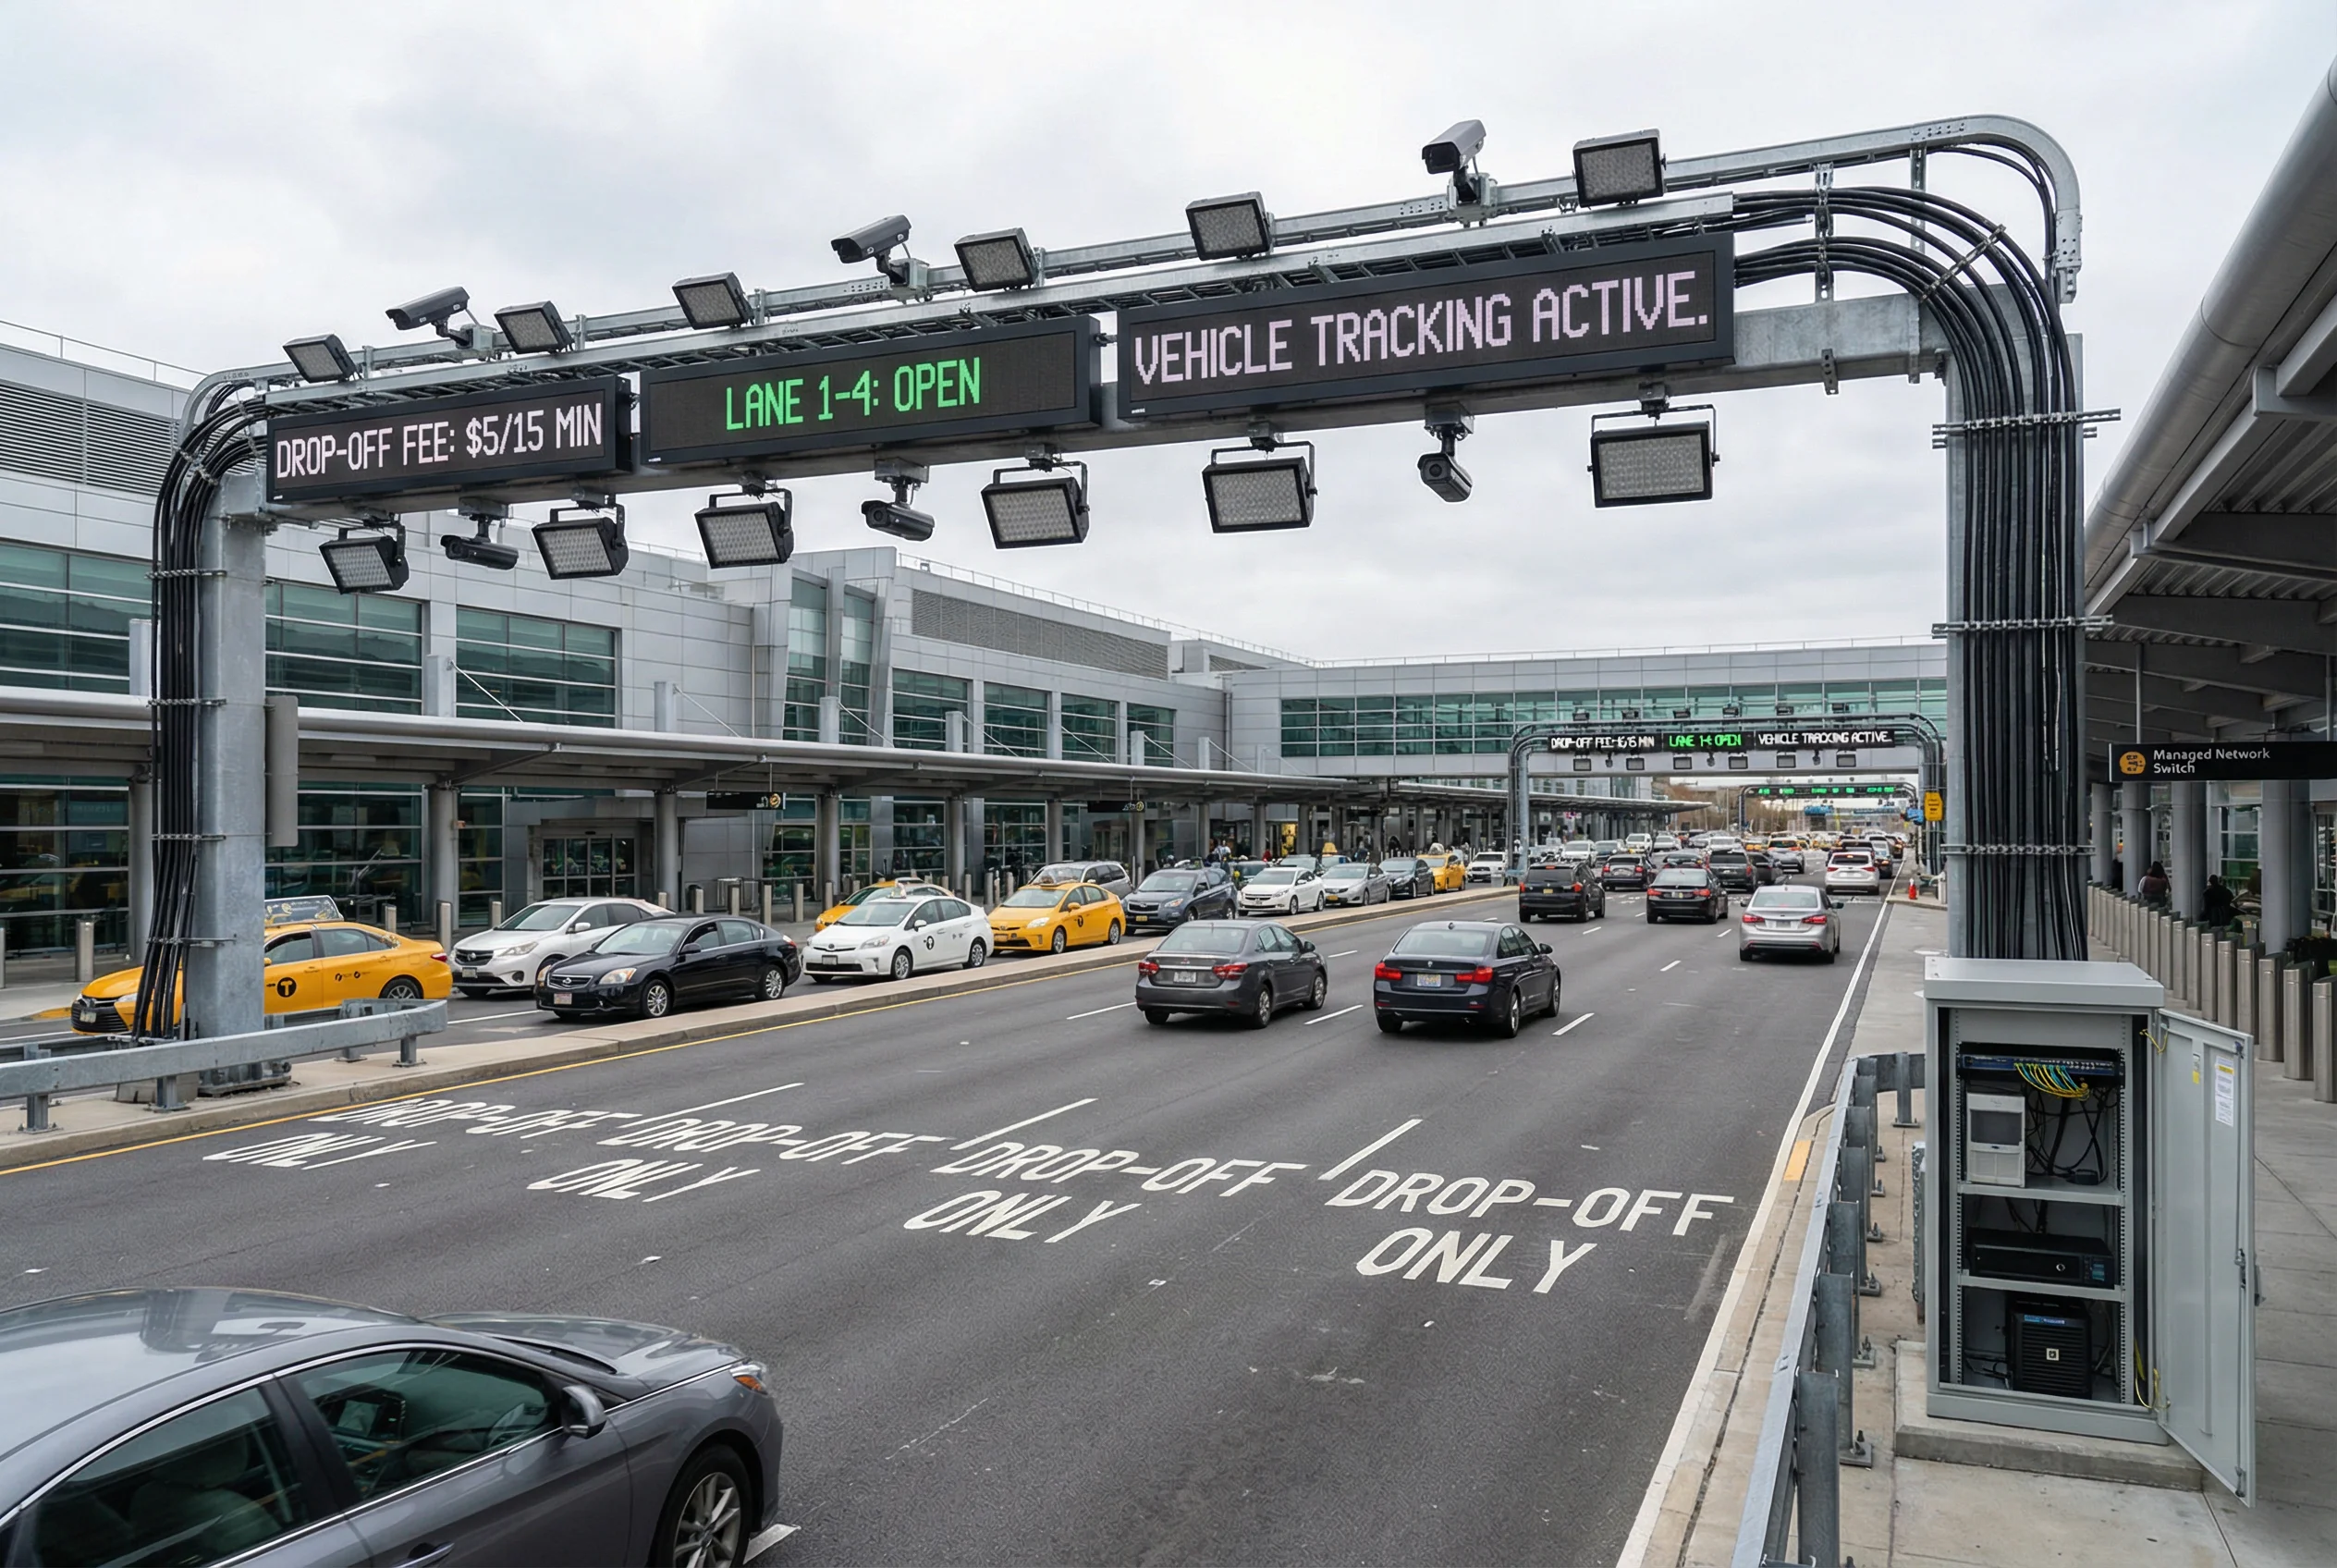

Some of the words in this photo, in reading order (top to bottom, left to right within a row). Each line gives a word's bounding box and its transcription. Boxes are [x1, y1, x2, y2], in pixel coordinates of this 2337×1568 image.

[1134, 319, 1293, 386] VEHICLE
[1310, 292, 1512, 367] TRACKING
[1532, 270, 1708, 343] ACTIVE.
[726, 378, 804, 431] LANE
[817, 370, 879, 421] 1-4:
[894, 356, 981, 412] OPEN
[276, 427, 393, 479] DROP-OFF
[402, 421, 456, 466] FEE:
[465, 410, 544, 459] $5/15
[556, 402, 602, 449] MIN
[2153, 748, 2212, 764] Managed
[2215, 747, 2271, 760] Network
[2153, 761, 2196, 775] Switch
[596, 1118, 948, 1165] DROP-OFF
[929, 1141, 1311, 1197] DROP-OFF
[526, 1158, 761, 1202] ONLY
[1324, 1169, 1735, 1236] DROP-OFF
[903, 1189, 1143, 1243] ONLY
[1356, 1227, 1598, 1294] ONLY
